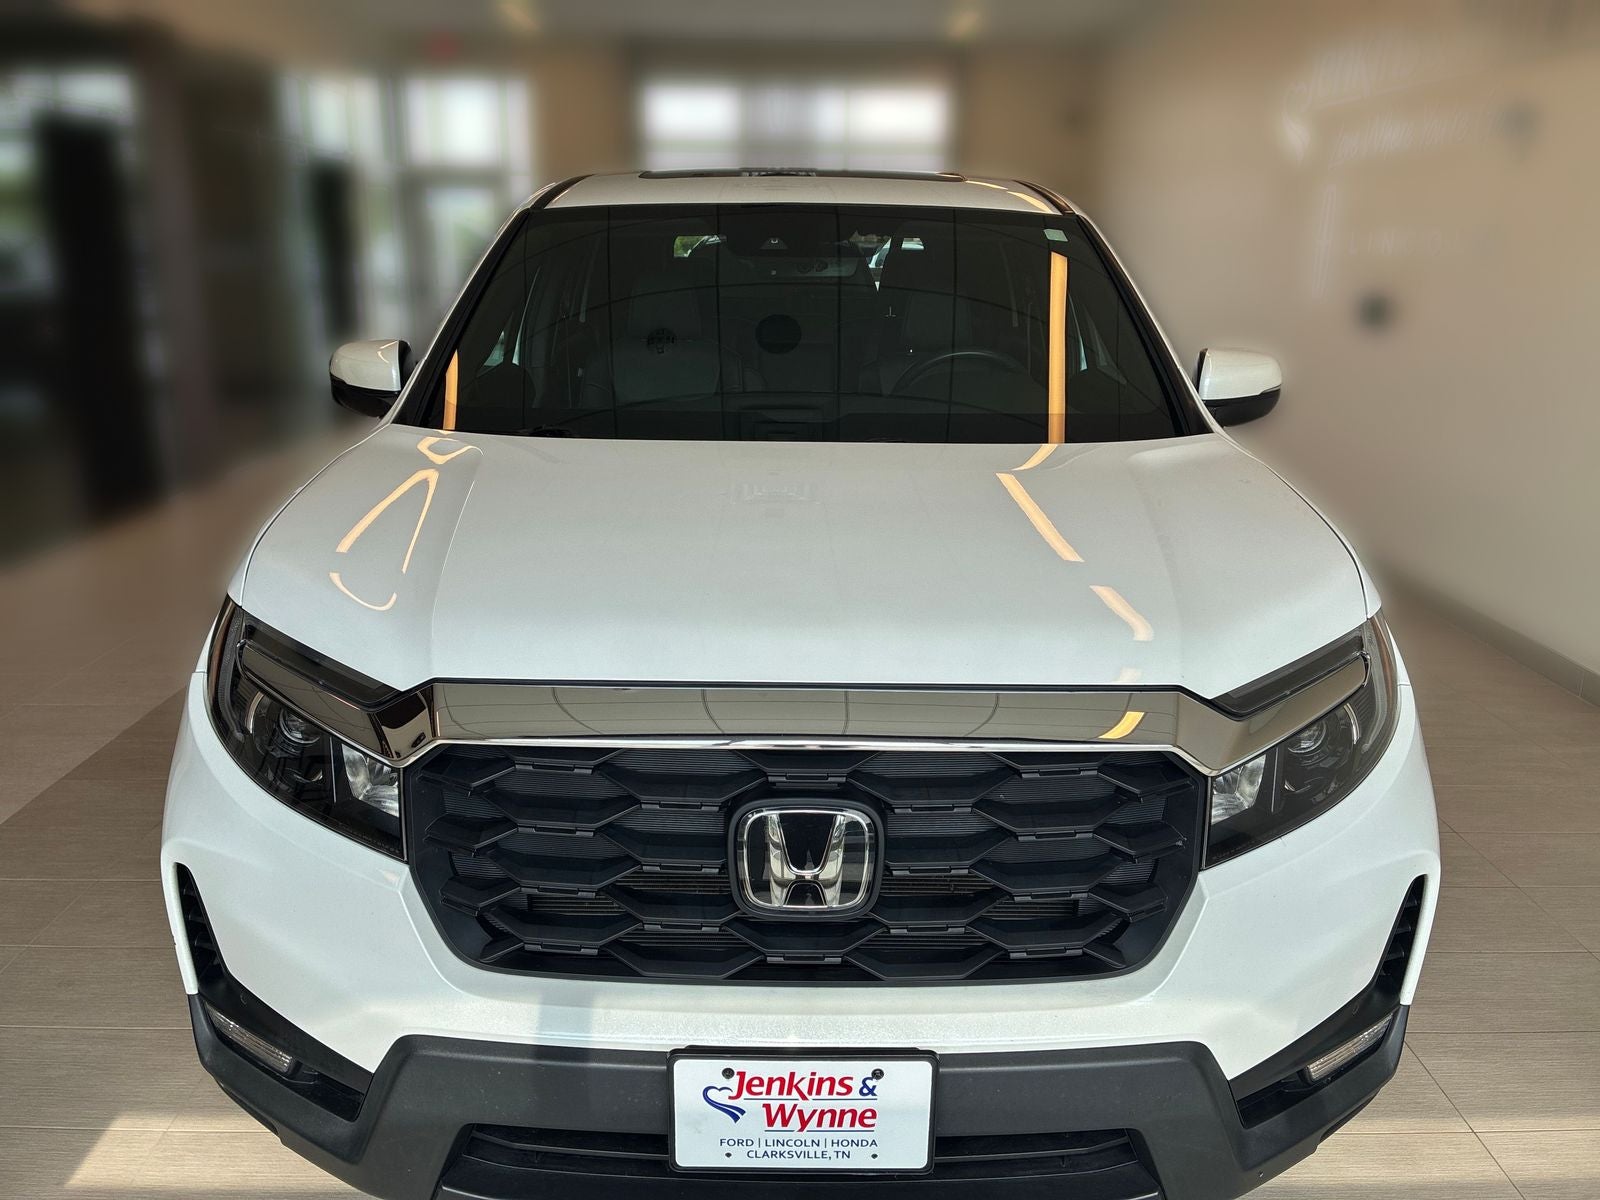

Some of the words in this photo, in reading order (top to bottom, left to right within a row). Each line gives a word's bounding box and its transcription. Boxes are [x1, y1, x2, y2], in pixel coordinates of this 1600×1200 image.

[728, 1071, 854, 1101] Jenkins
[858, 1076, 878, 1097] &
[762, 1103, 878, 1132] Wynne
[719, 1138, 754, 1147] FORD
[764, 1138, 820, 1148] LINCOLN
[831, 1138, 878, 1148] HONDA
[746, 1149, 832, 1160] CLARKSVILLE,
[833, 1150, 851, 1159] TN
